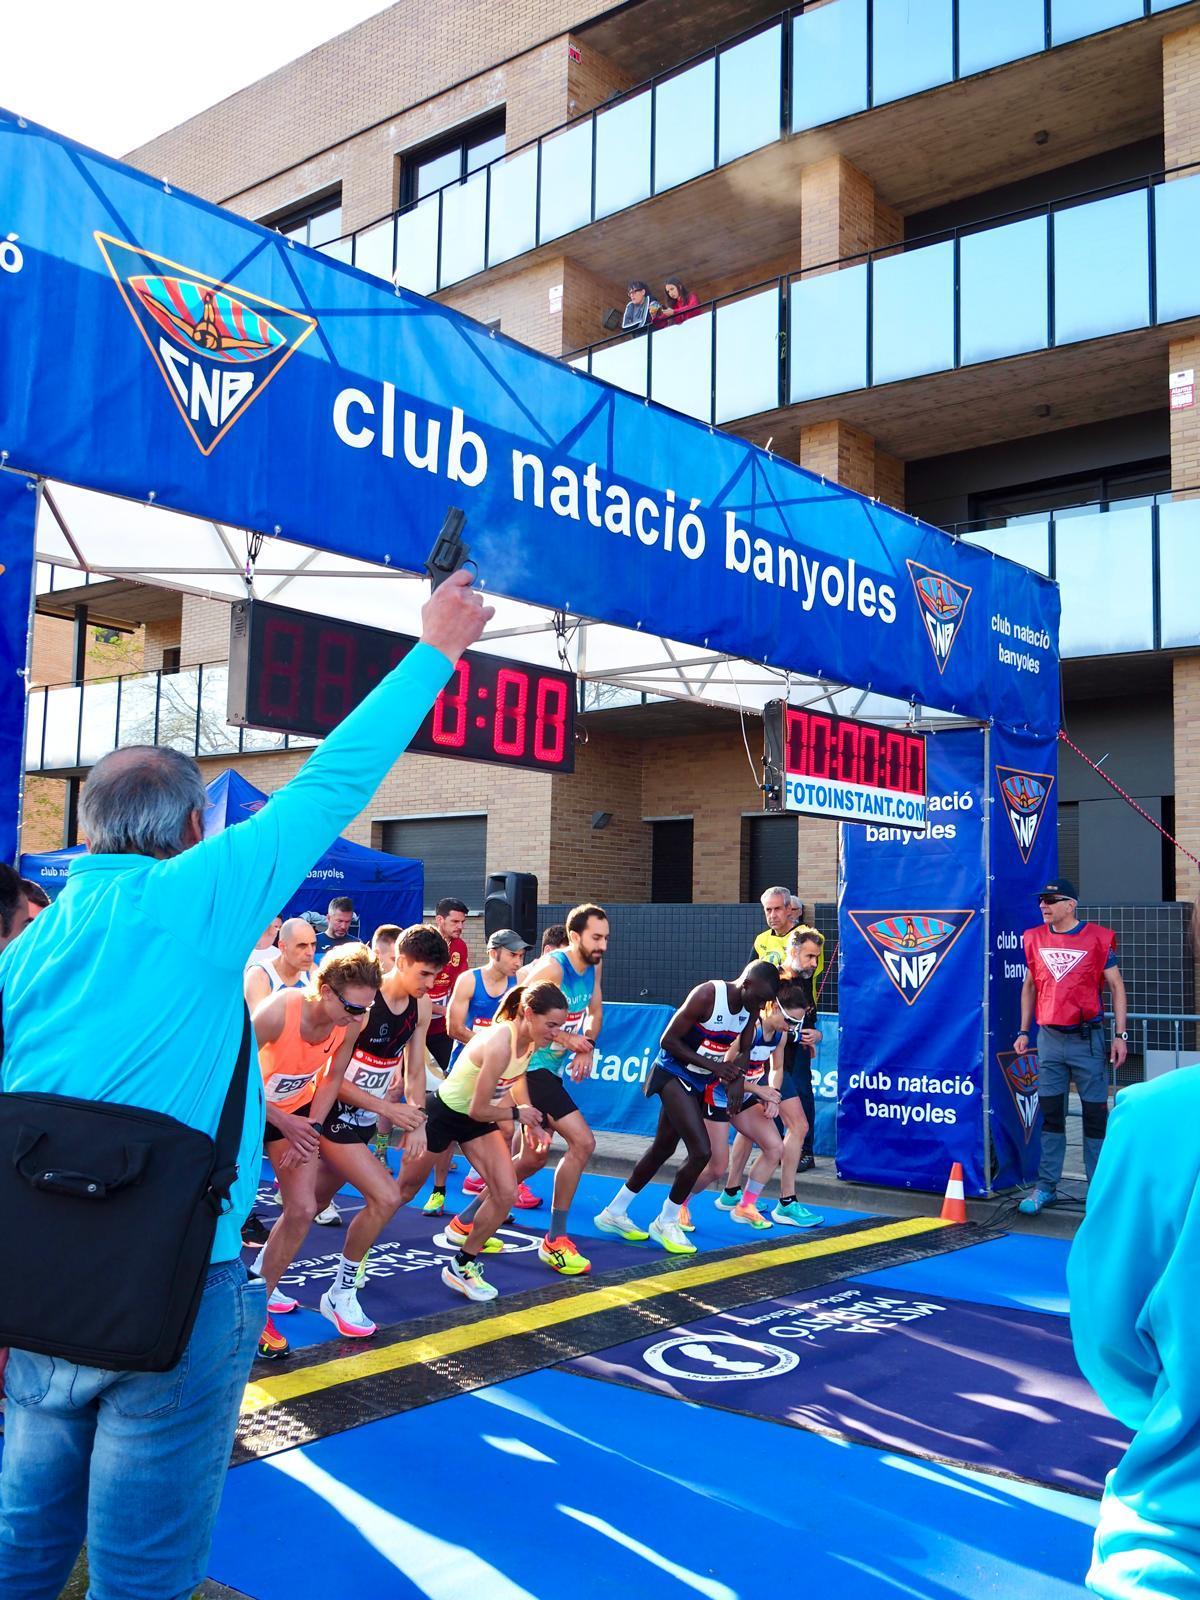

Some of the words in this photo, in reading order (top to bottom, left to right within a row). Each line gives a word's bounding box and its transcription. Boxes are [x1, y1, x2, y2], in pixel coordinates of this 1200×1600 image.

[333, 381, 488, 487] club
[512, 449, 705, 559] natació
[725, 511, 897, 624] banyoles
[991, 613, 1011, 636] club
[1013, 625, 1050, 649] natació
[998, 642, 1041, 674] banyoles
[927, 791, 974, 812] ació
[41, 867, 58, 877] club
[997, 931, 1018, 950] club
[1004, 960, 1027, 982] bany
[355, 1071, 386, 1088] 201
[850, 1071, 891, 1091] club
[898, 1075, 975, 1096] natació
[864, 1099, 957, 1126] banyoles
[768, 1296, 907, 1341] MARATÓ
